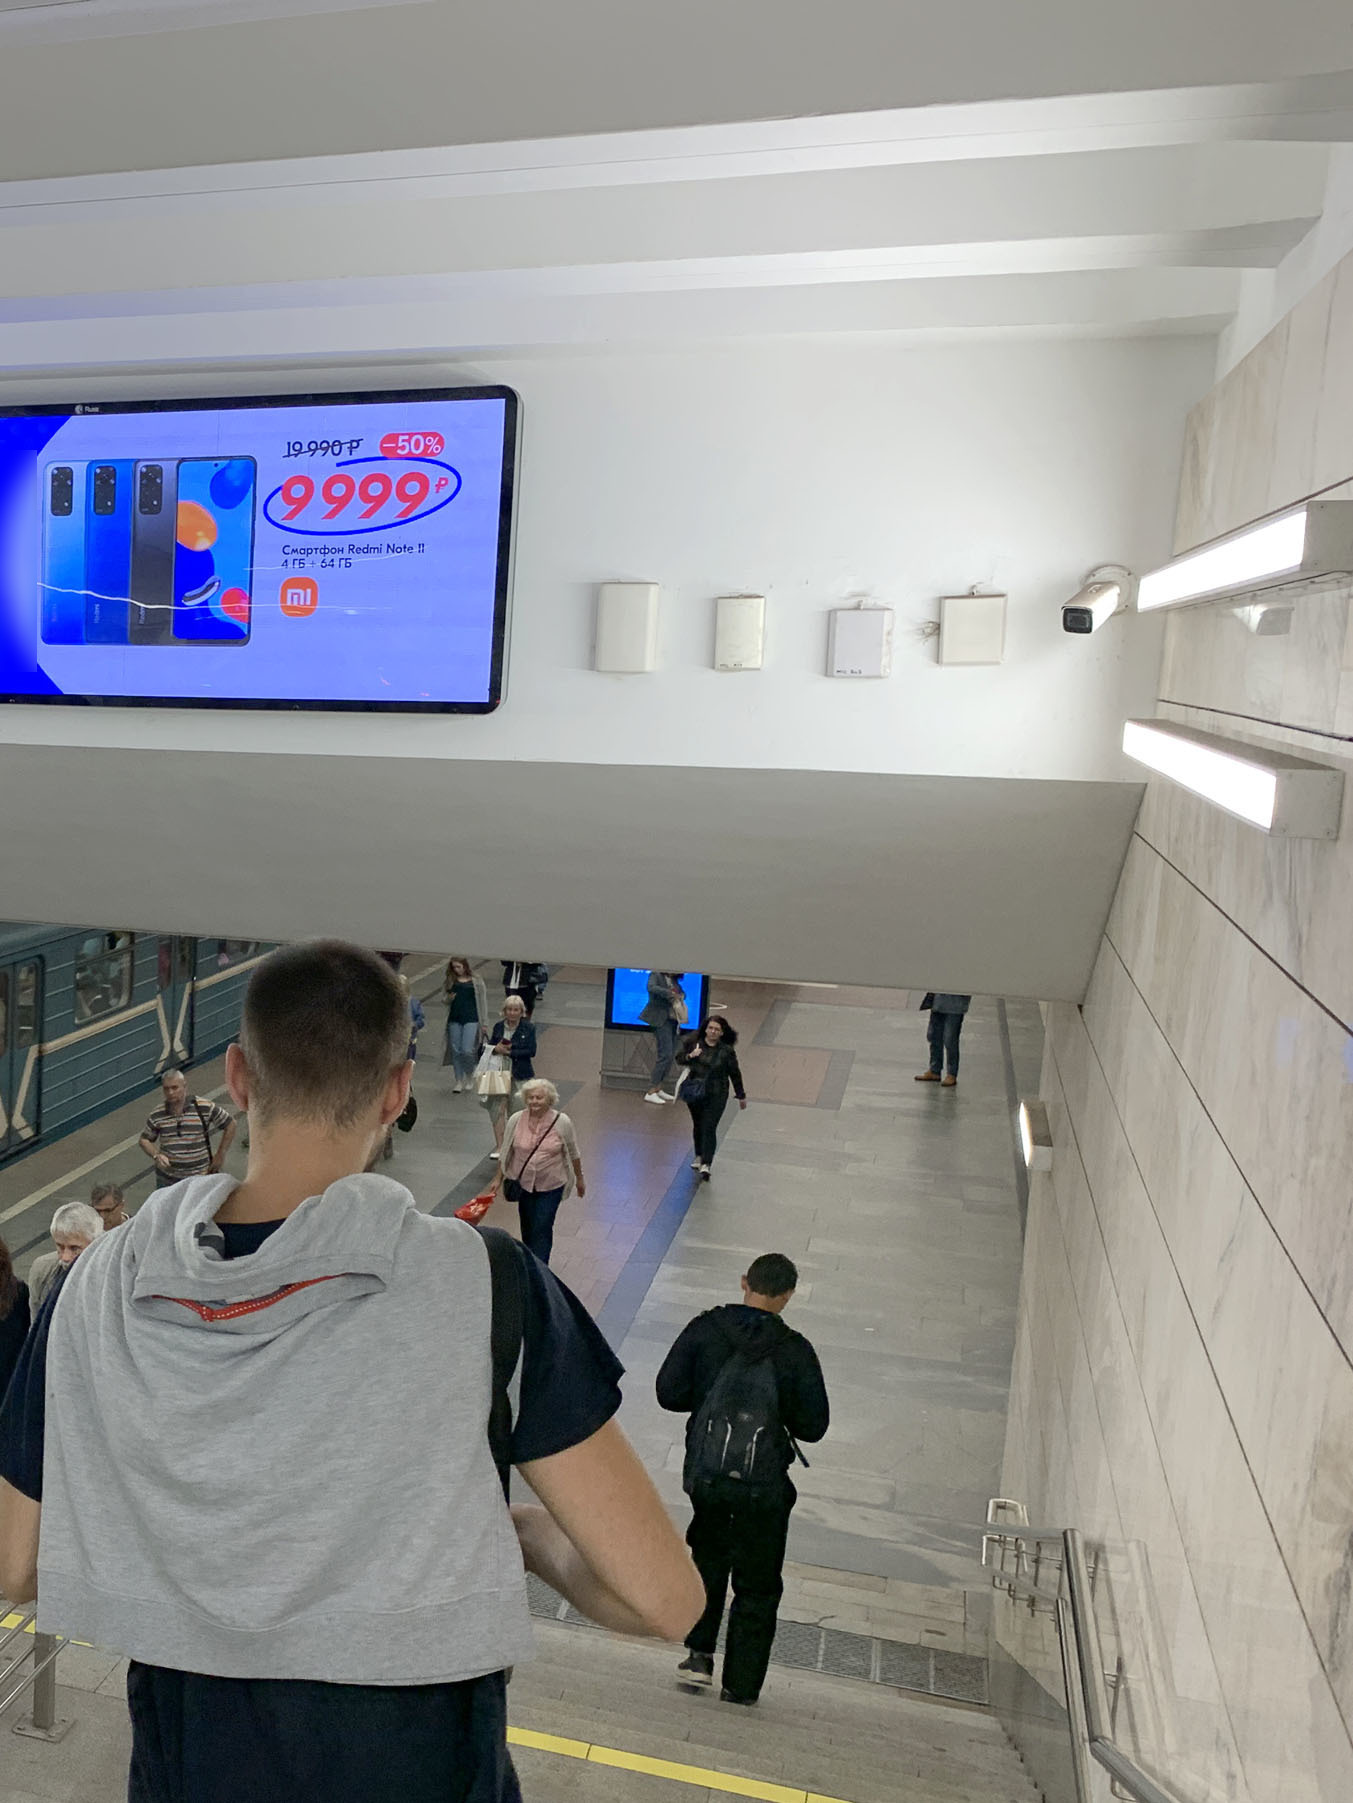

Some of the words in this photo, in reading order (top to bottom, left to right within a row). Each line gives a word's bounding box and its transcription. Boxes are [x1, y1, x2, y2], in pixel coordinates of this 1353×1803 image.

[382, 434, 442, 455] -50%
[282, 544, 345, 557] Смартфон
[347, 543, 383, 555] Redmi
[386, 543, 414, 554] Note
[281, 558, 288, 569] 4
[292, 558, 306, 569] ГБ
[320, 558, 335, 569] 64
[338, 557, 352, 569] ГБ
